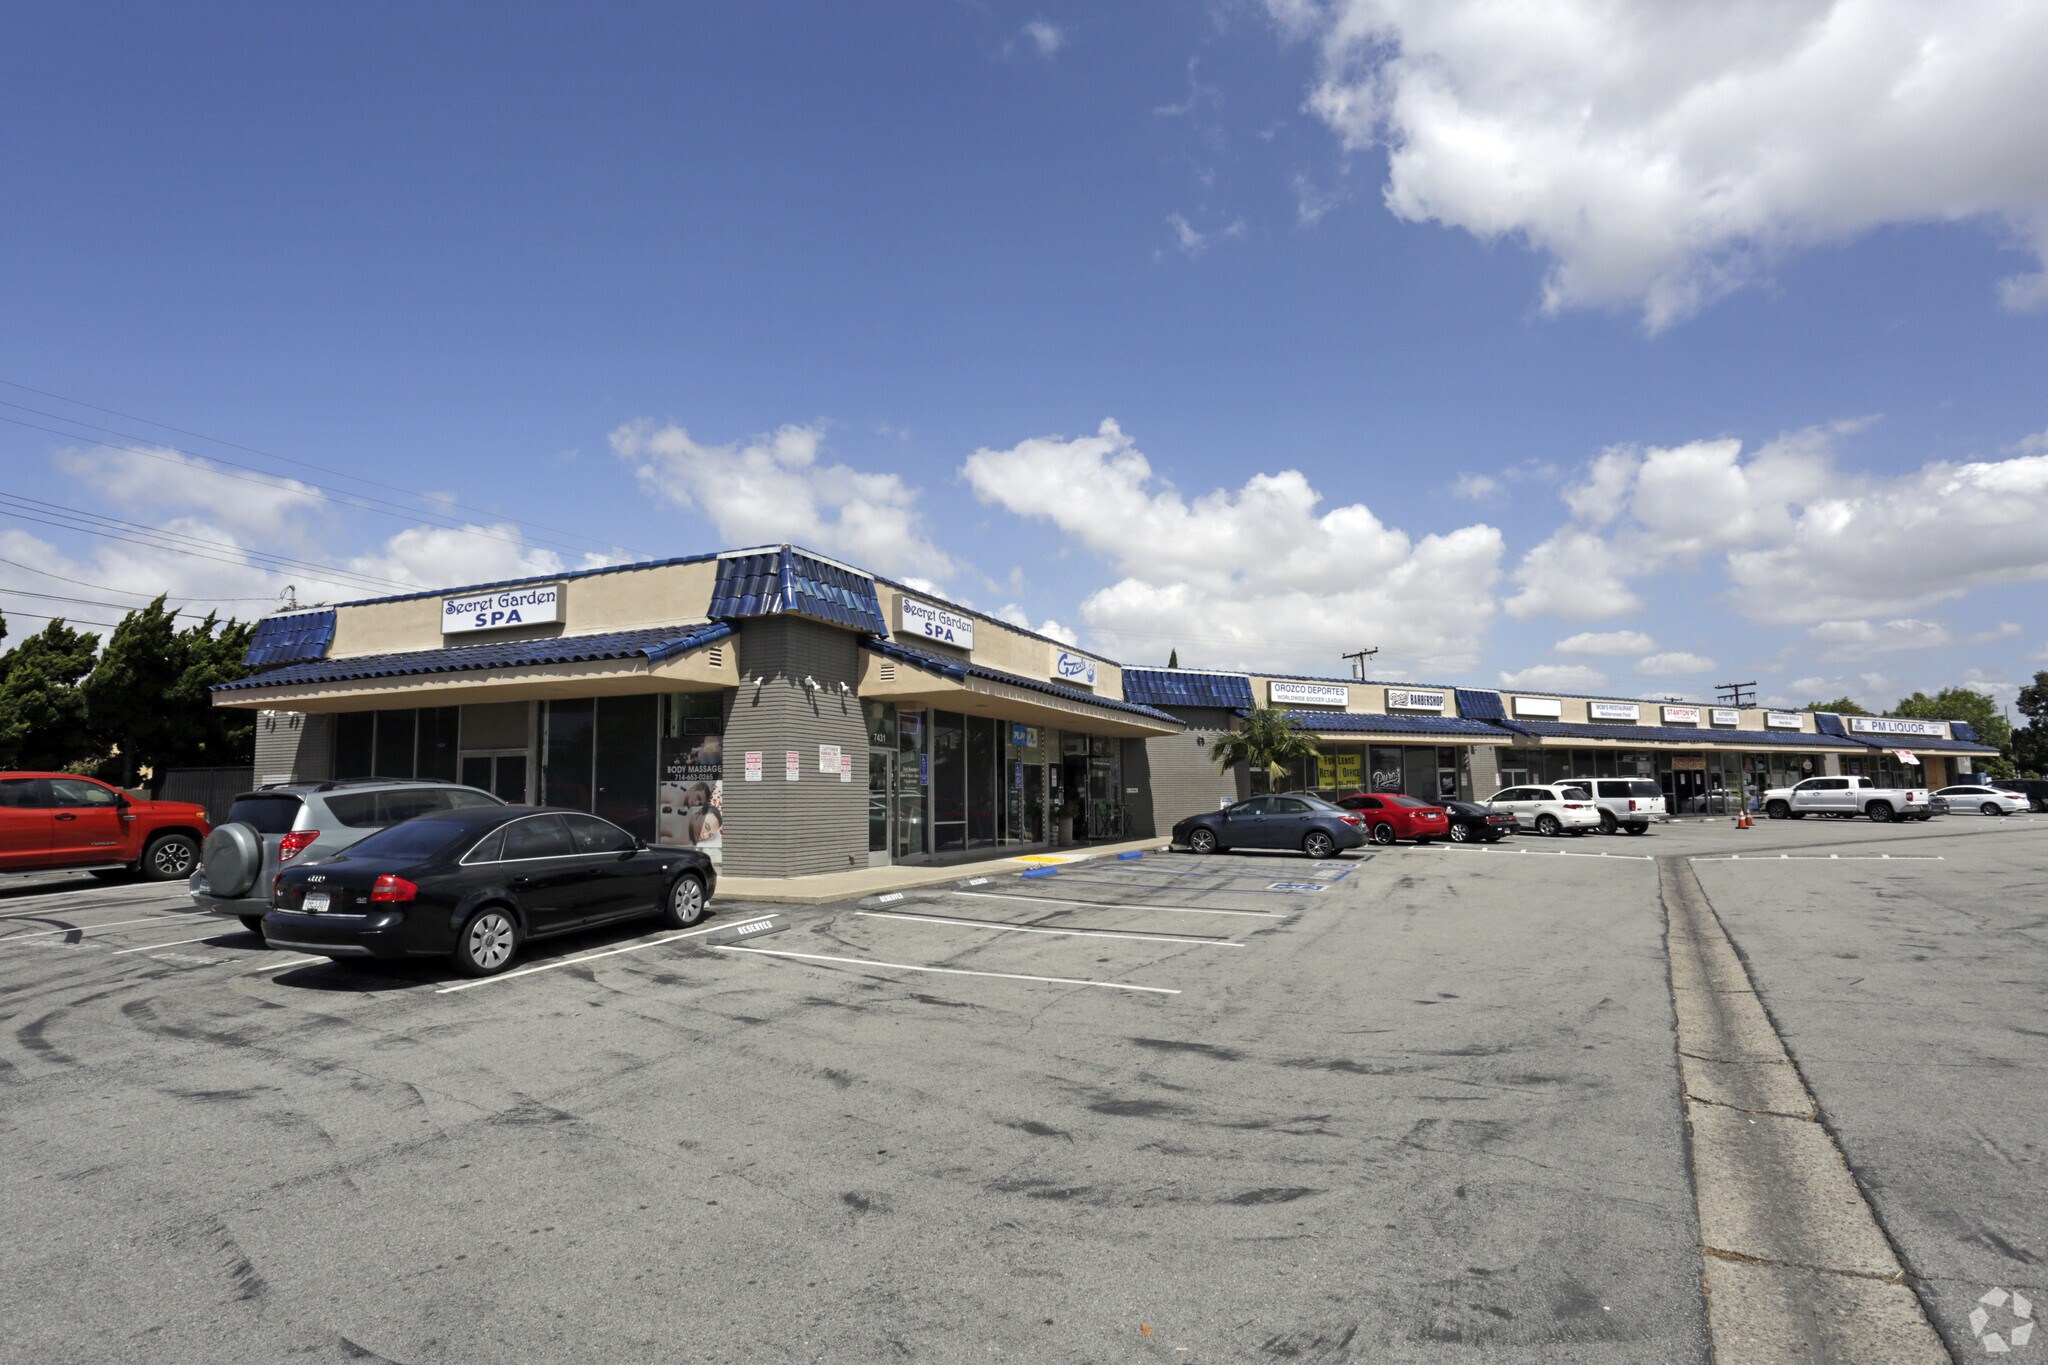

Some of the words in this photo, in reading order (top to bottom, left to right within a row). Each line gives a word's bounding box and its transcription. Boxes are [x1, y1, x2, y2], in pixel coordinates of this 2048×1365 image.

[445, 597, 493, 615] Secret
[498, 590, 556, 608] Garden
[475, 609, 522, 627] SPA
[903, 599, 936, 621] Secret
[938, 611, 972, 633] Garden
[925, 622, 954, 643] SPA
[1274, 683, 1306, 694] OROZCO
[1307, 685, 1345, 696] DEPORTES
[1277, 694, 1305, 702] WORLDWIDE
[1410, 694, 1444, 706] BARBERSHOP
[1872, 721, 1886, 731] PM
[1889, 723, 1925, 733] LIQUOR
[873, 733, 886, 742] 7431
[1338, 756, 1355, 765] LEASE
[667, 765, 687, 773] BODY
[688, 765, 722, 773] MASSAGE
[1342, 767, 1360, 777] OFFICE
[878, 892, 904, 902] RESERVED
[736, 920, 773, 935] RESERVED
